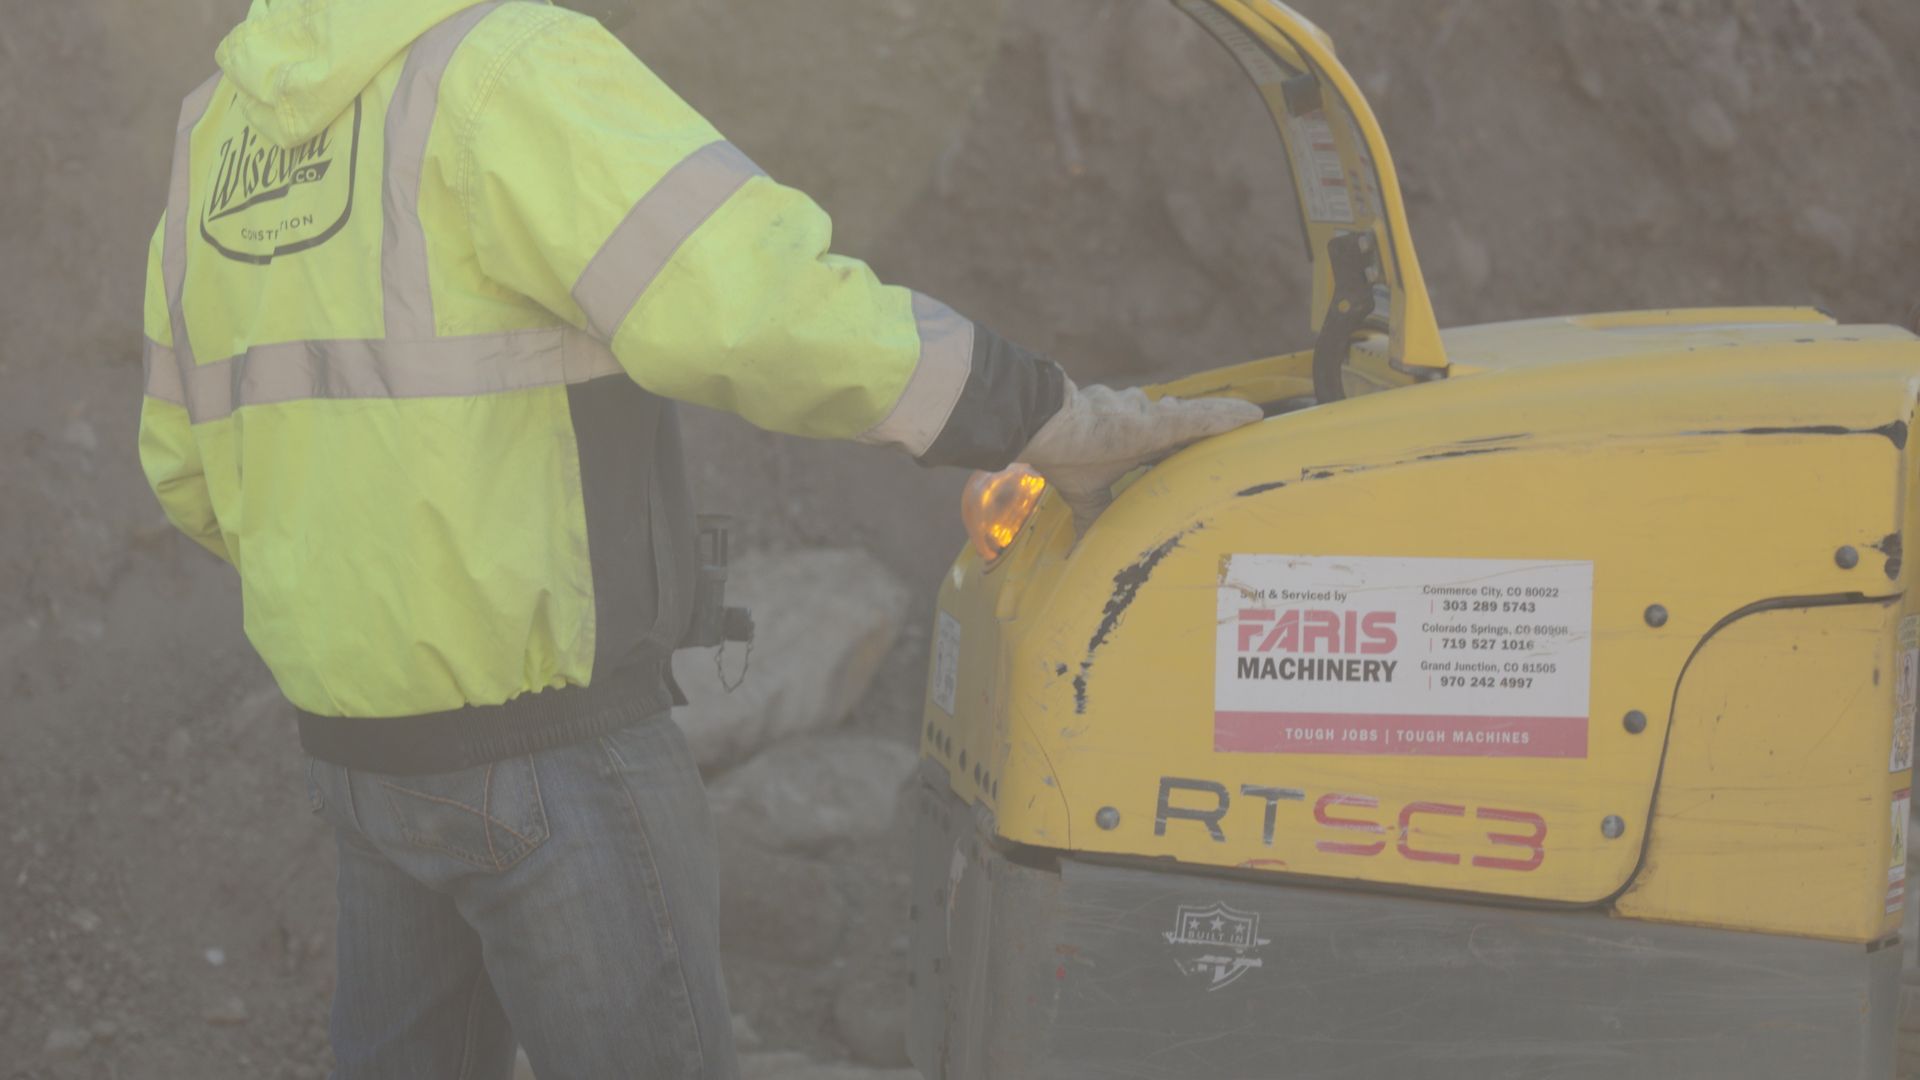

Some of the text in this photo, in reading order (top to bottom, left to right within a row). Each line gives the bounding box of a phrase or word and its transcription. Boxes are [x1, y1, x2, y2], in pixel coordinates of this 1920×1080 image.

[1268, 589, 1278, 600] &
[1281, 590, 1331, 600] Serviced
[1334, 591, 1348, 603] by
[1423, 584, 1559, 598] Commerce City, CO 80022
[1443, 600, 1536, 613] 303 289 5743
[1237, 608, 1398, 655] FARIS
[1422, 622, 1468, 633] Colorado
[1471, 624, 1512, 636] Springs,
[1515, 625, 1530, 635] CO
[1442, 638, 1535, 650] 719 527 1016
[1237, 657, 1398, 682] MACHINERY
[1420, 661, 1557, 673] Grand Junction, CO 81505
[1440, 676, 1533, 688] 970 242 4997
[1285, 727, 1530, 744] TOUGH JOBS TOUGH MACHINES
[1188, 930, 1244, 943] BUILT IN
